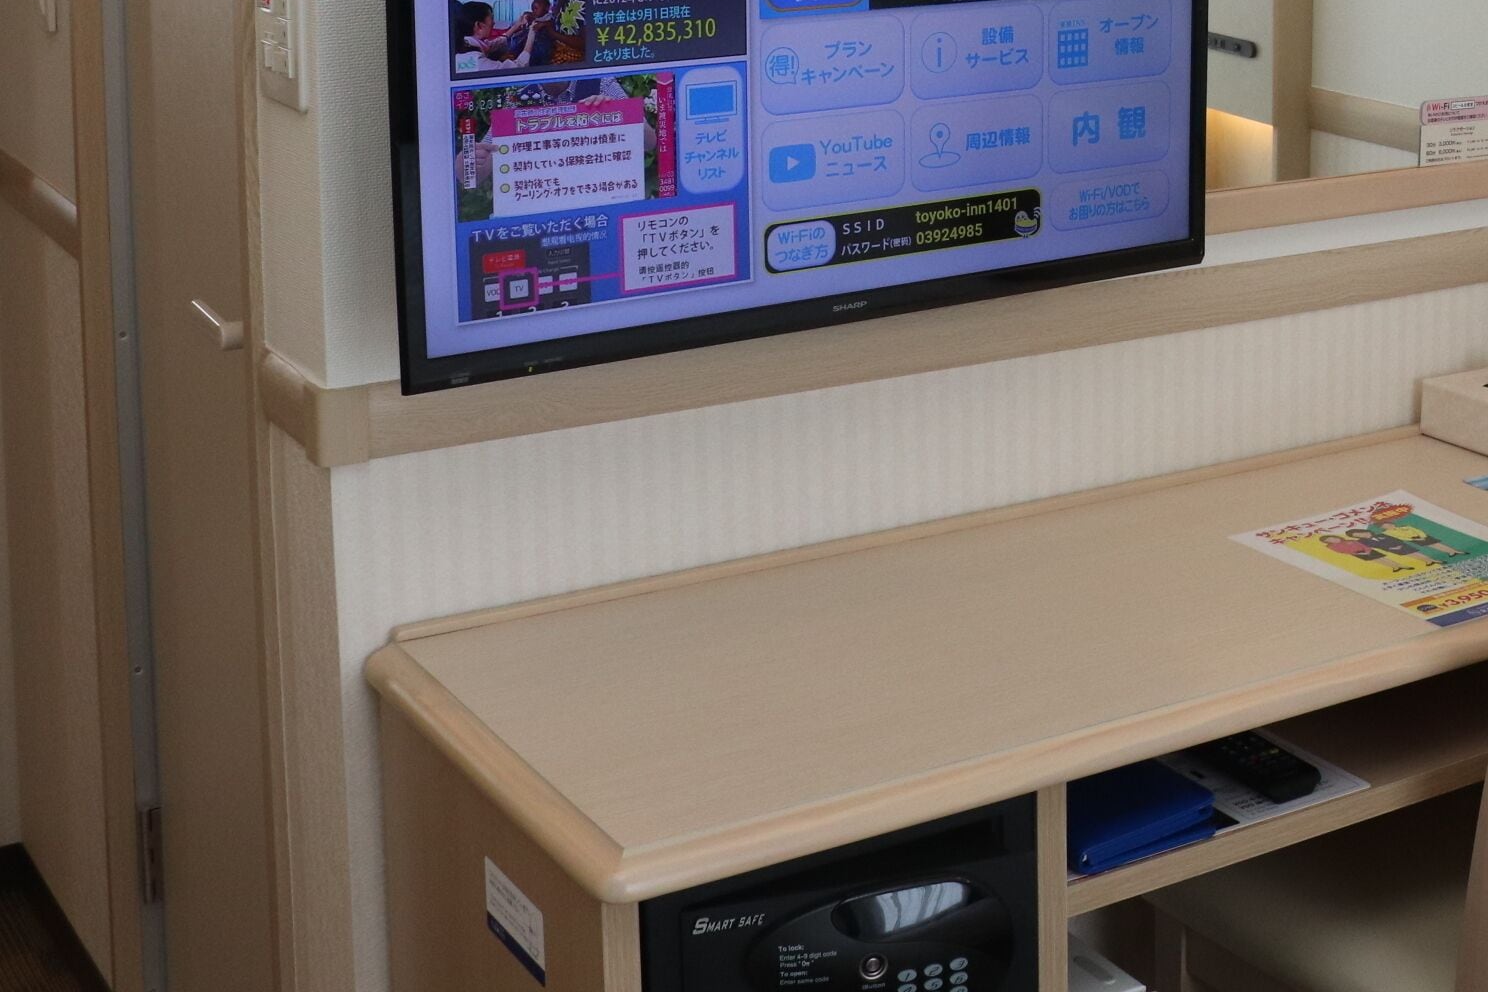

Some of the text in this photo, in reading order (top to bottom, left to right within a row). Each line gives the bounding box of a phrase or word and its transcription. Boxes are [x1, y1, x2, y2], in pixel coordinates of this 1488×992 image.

[592, 7, 691, 24] 寄付金は9月1日現在
[1099, 14, 1160, 34] オープン
[981, 26, 1015, 45] 設備
[593, 46, 655, 63] となりました。
[824, 41, 873, 58] プラン
[1115, 37, 1145, 56] 情報
[965, 48, 1030, 67] サービス
[801, 62, 895, 86] キャンペーン
[515, 112, 624, 133] トラブルを防ぐには
[511, 133, 627, 153] 修理工事等の契約は慎重に
[695, 130, 728, 145] テレビ
[819, 135, 893, 155] YouTube
[965, 127, 1031, 152] 周辺情報
[512, 151, 632, 174] 契約している保険会社に確認
[685, 148, 739, 165] チャンネル
[697, 167, 727, 180] リスト
[826, 156, 888, 178] ニュース
[514, 176, 561, 190] 契約後でも
[915, 197, 1018, 225] toyoko-inn1401
[637, 215, 689, 231] リモコンの
[777, 228, 825, 245] Wi-Fiの
[915, 223, 983, 246] 03924985
[637, 240, 715, 260] 押してください。
[775, 245, 829, 263] つなぎ方
[832, 300, 868, 313] SHARP
[692, 913, 766, 936] SMART SAFE
[788, 944, 805, 952] lock:
[929, 967, 939, 975] 2
